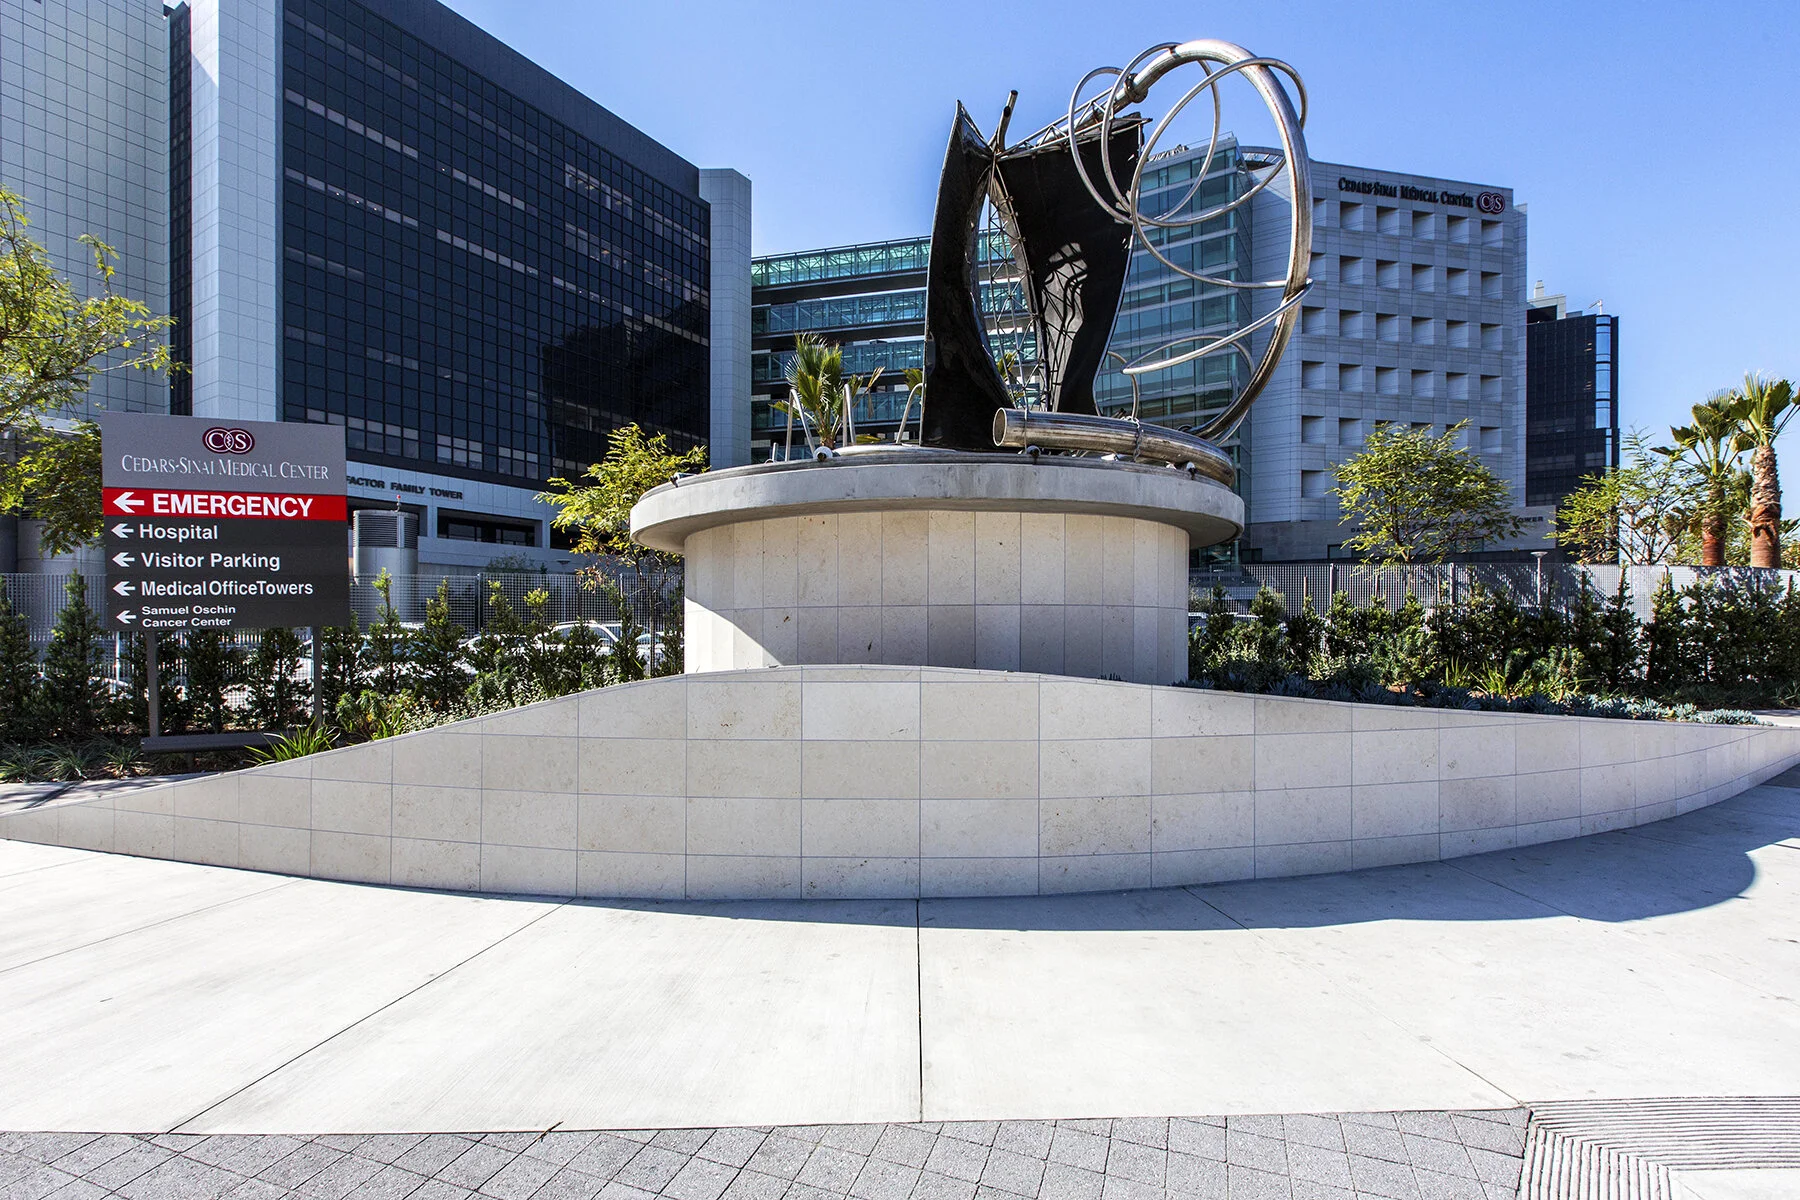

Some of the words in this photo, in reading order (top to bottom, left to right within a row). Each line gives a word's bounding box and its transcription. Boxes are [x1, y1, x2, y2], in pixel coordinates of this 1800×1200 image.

[1400, 185, 1439, 204] MEDICAL
[1440, 191, 1474, 208] CENTER
[121, 454, 214, 475] CEDARS-SINAI
[218, 459, 277, 478] MEDICAL
[280, 461, 329, 480] CENTER
[346, 475, 386, 489] FACTOR
[390, 481, 426, 495] FAMILY
[428, 487, 463, 500] TOWER
[152, 493, 313, 517] EMERGENCY
[139, 523, 218, 543] Hospital
[141, 552, 204, 568] Visitor
[210, 552, 281, 572] Parking
[141, 605, 189, 616] Samuel
[192, 604, 236, 615] Oschin
[142, 618, 188, 628] Cancer
[190, 617, 232, 627] Center
